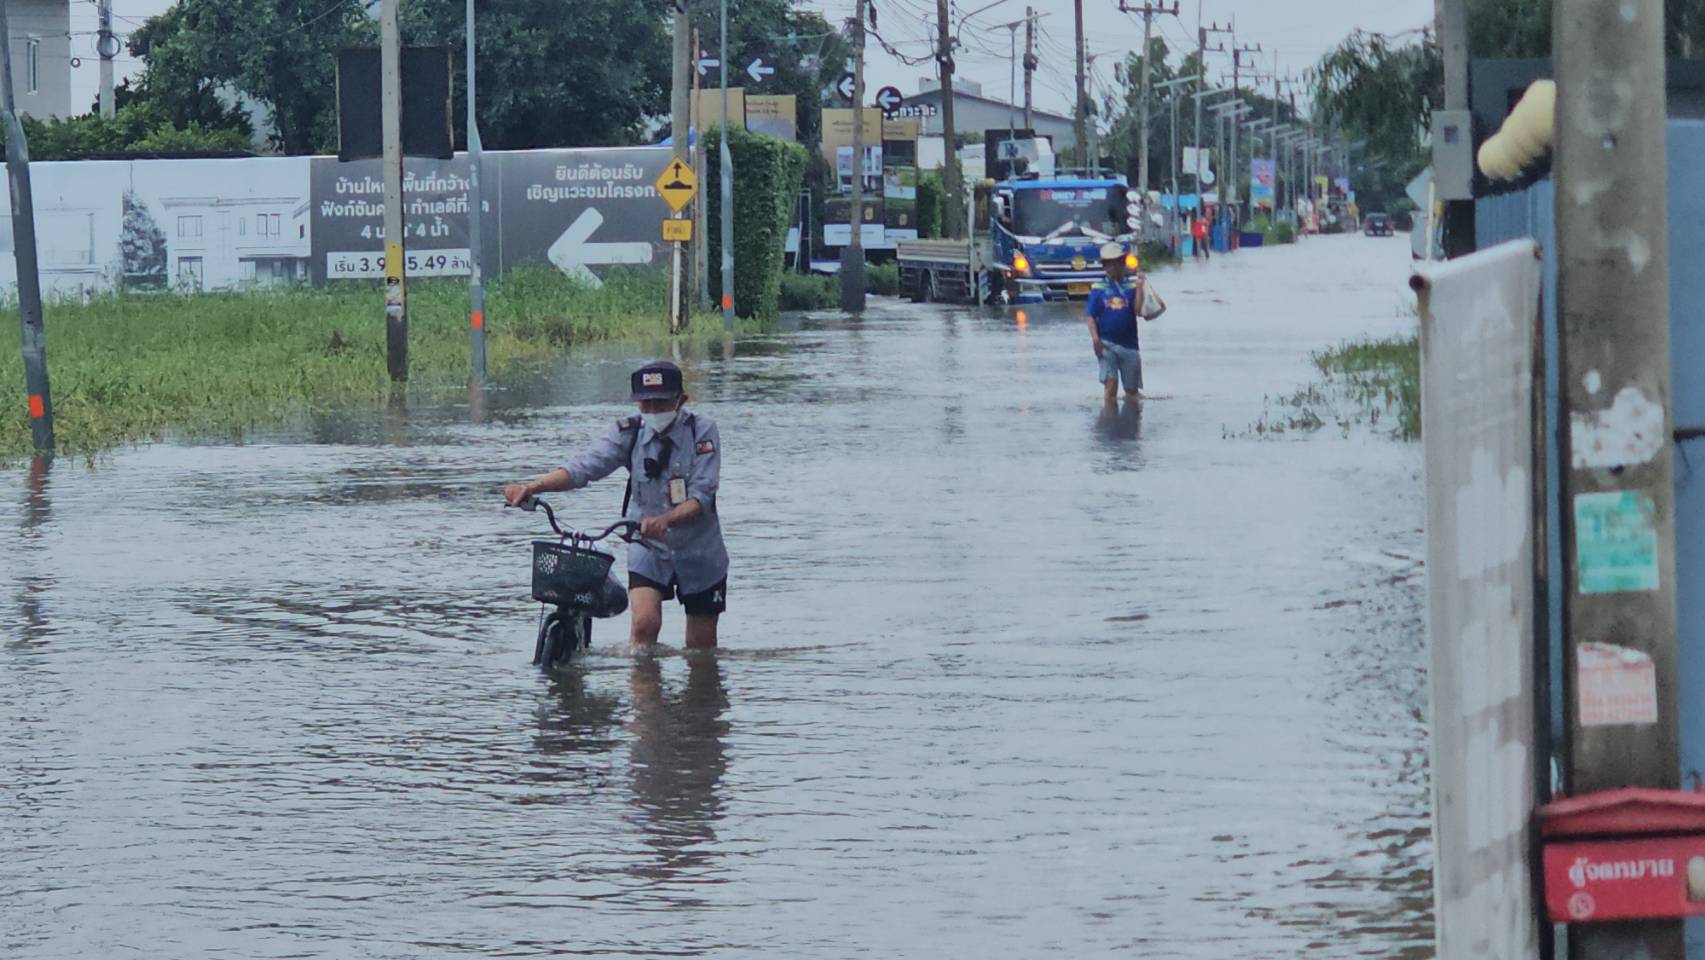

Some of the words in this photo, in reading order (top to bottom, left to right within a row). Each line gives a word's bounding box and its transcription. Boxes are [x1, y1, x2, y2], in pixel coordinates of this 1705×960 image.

[555, 163, 644, 181] ยินดีต้อนรับ
[526, 181, 662, 203] เชิญแวะชมโครงก
[360, 224, 371, 240] 4
[415, 223, 427, 238] 4
